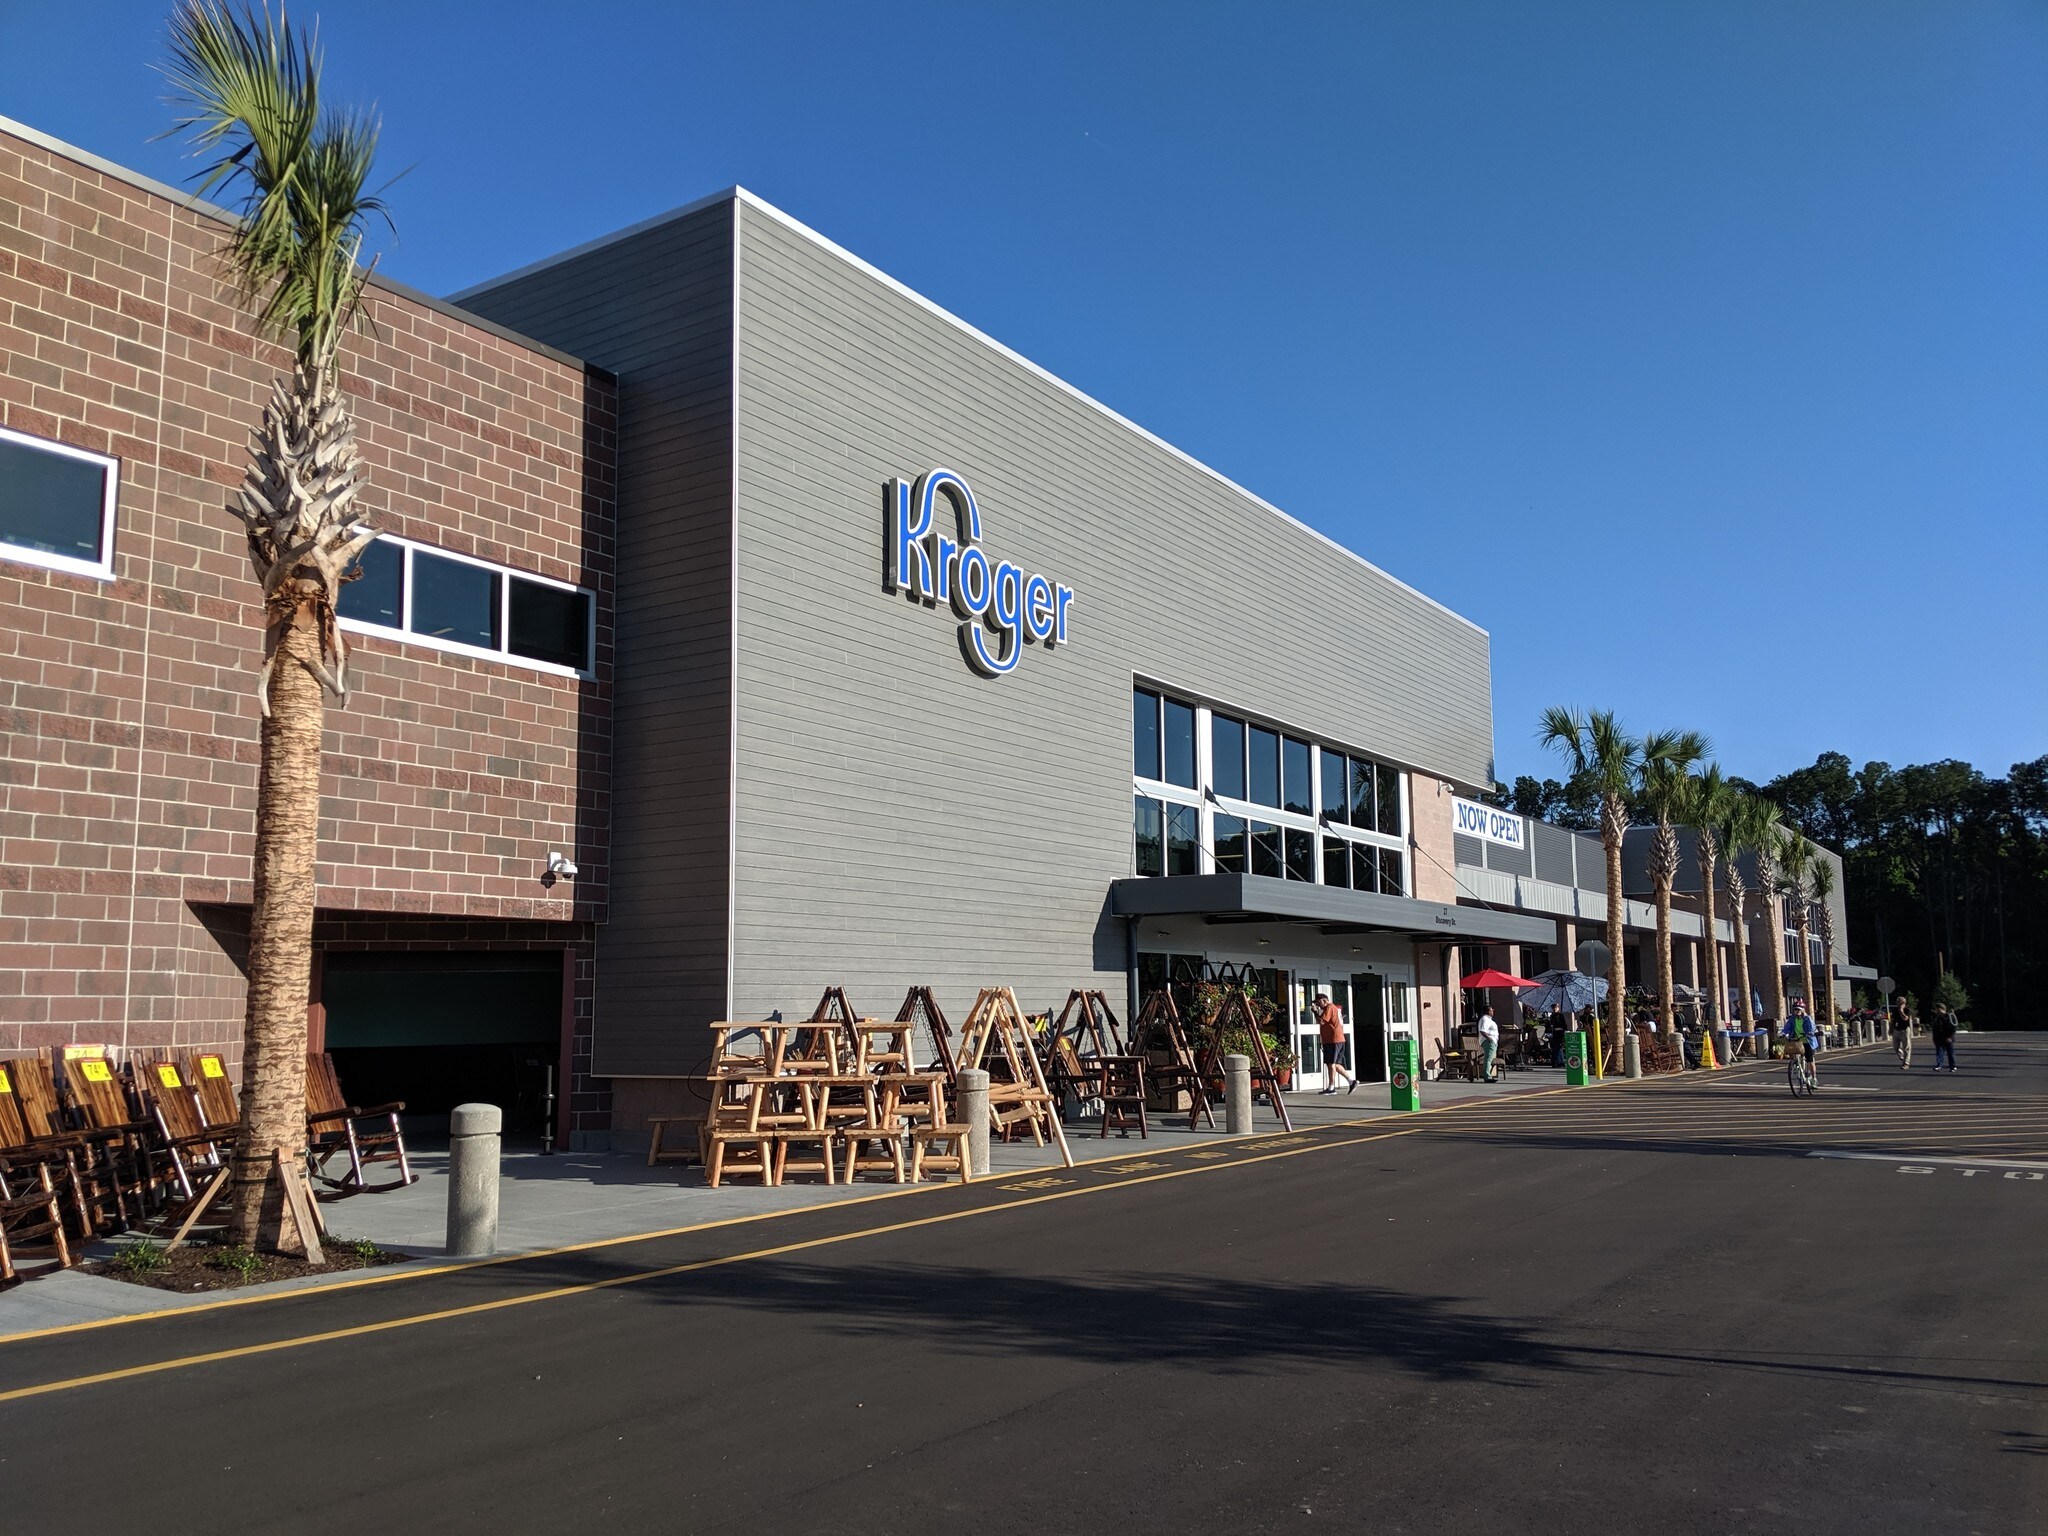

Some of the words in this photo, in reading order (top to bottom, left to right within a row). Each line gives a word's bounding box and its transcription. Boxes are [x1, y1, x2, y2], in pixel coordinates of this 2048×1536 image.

[893, 467, 1074, 674] Kroger
[1457, 802, 1488, 835] NOW
[1490, 812, 1520, 844] OPEN
[996, 1177, 1078, 1192] FIRE
[1091, 1161, 1173, 1175] LANE
[1183, 1151, 1230, 1160] NO
[1235, 1137, 1320, 1151] PARKING
